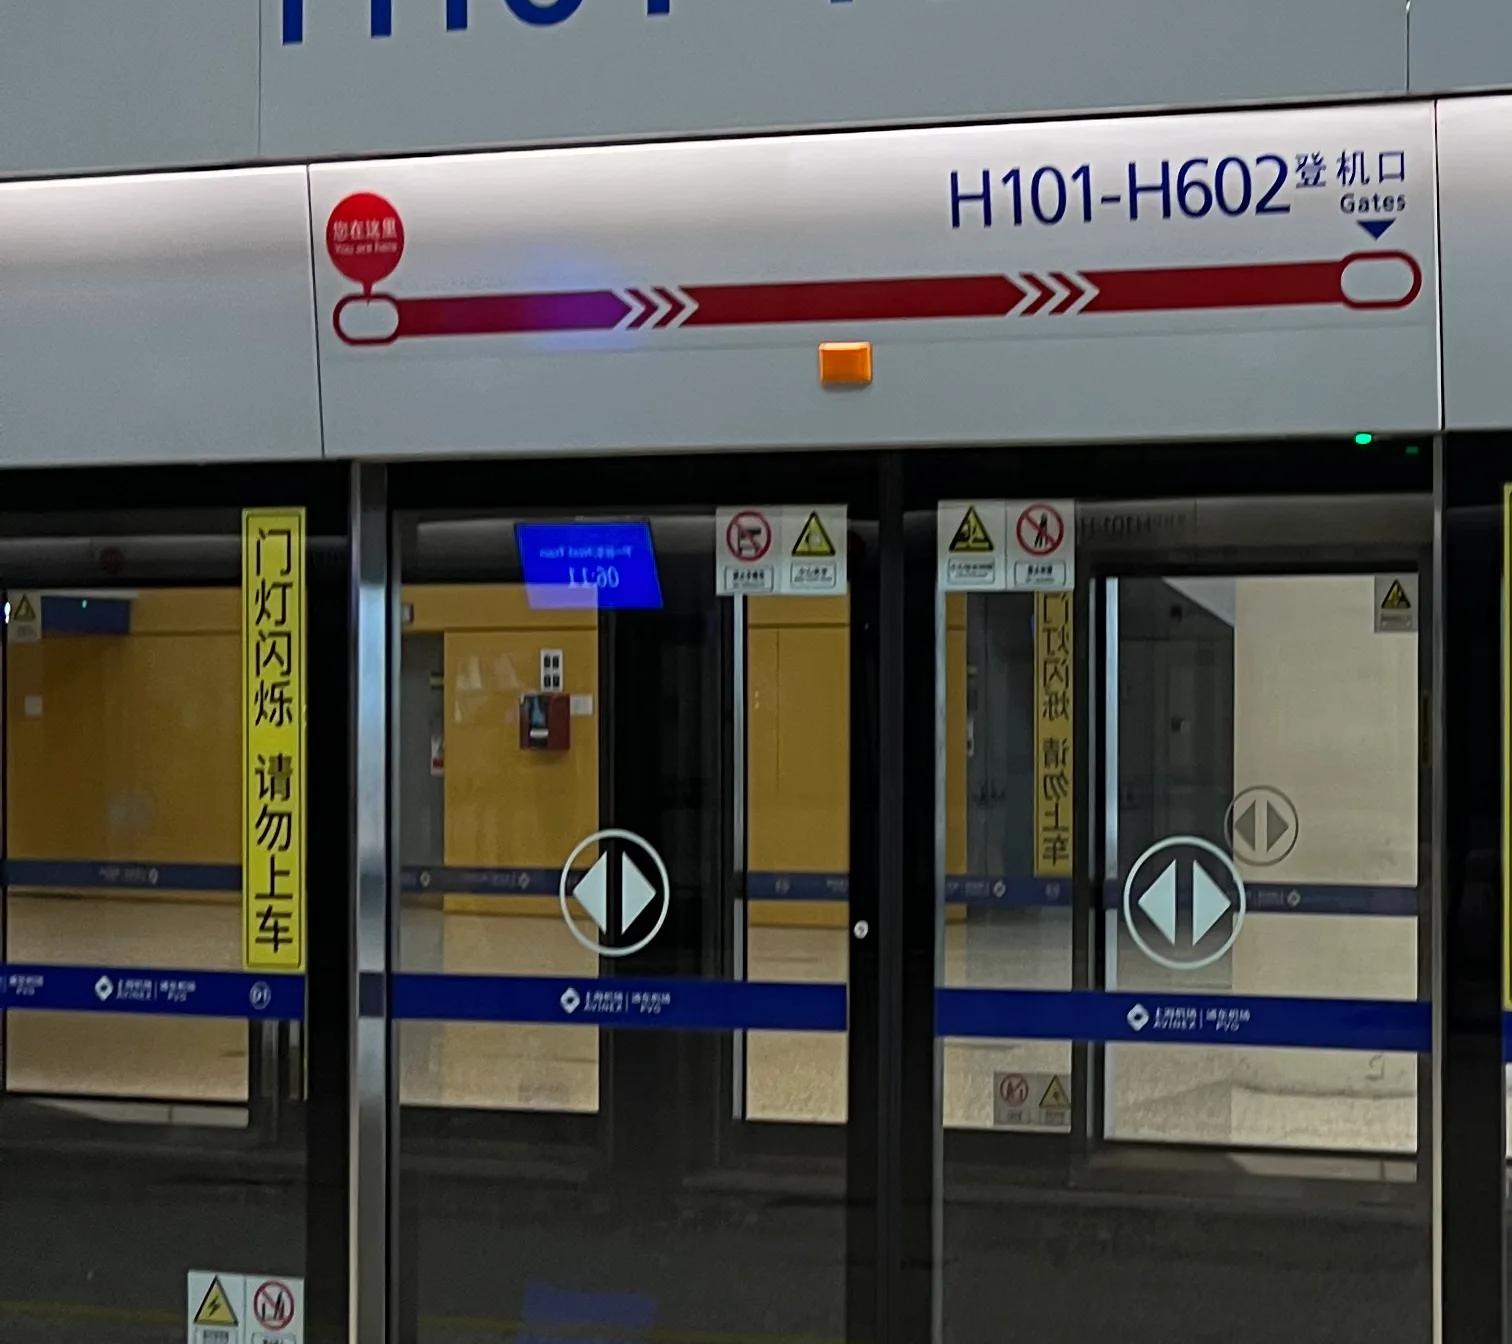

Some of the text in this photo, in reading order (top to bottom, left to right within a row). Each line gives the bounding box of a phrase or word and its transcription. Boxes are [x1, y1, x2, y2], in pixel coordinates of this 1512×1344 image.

[1339, 192, 1407, 215] Gates
[253, 527, 294, 954] 门灯闪烁 请勿上车
